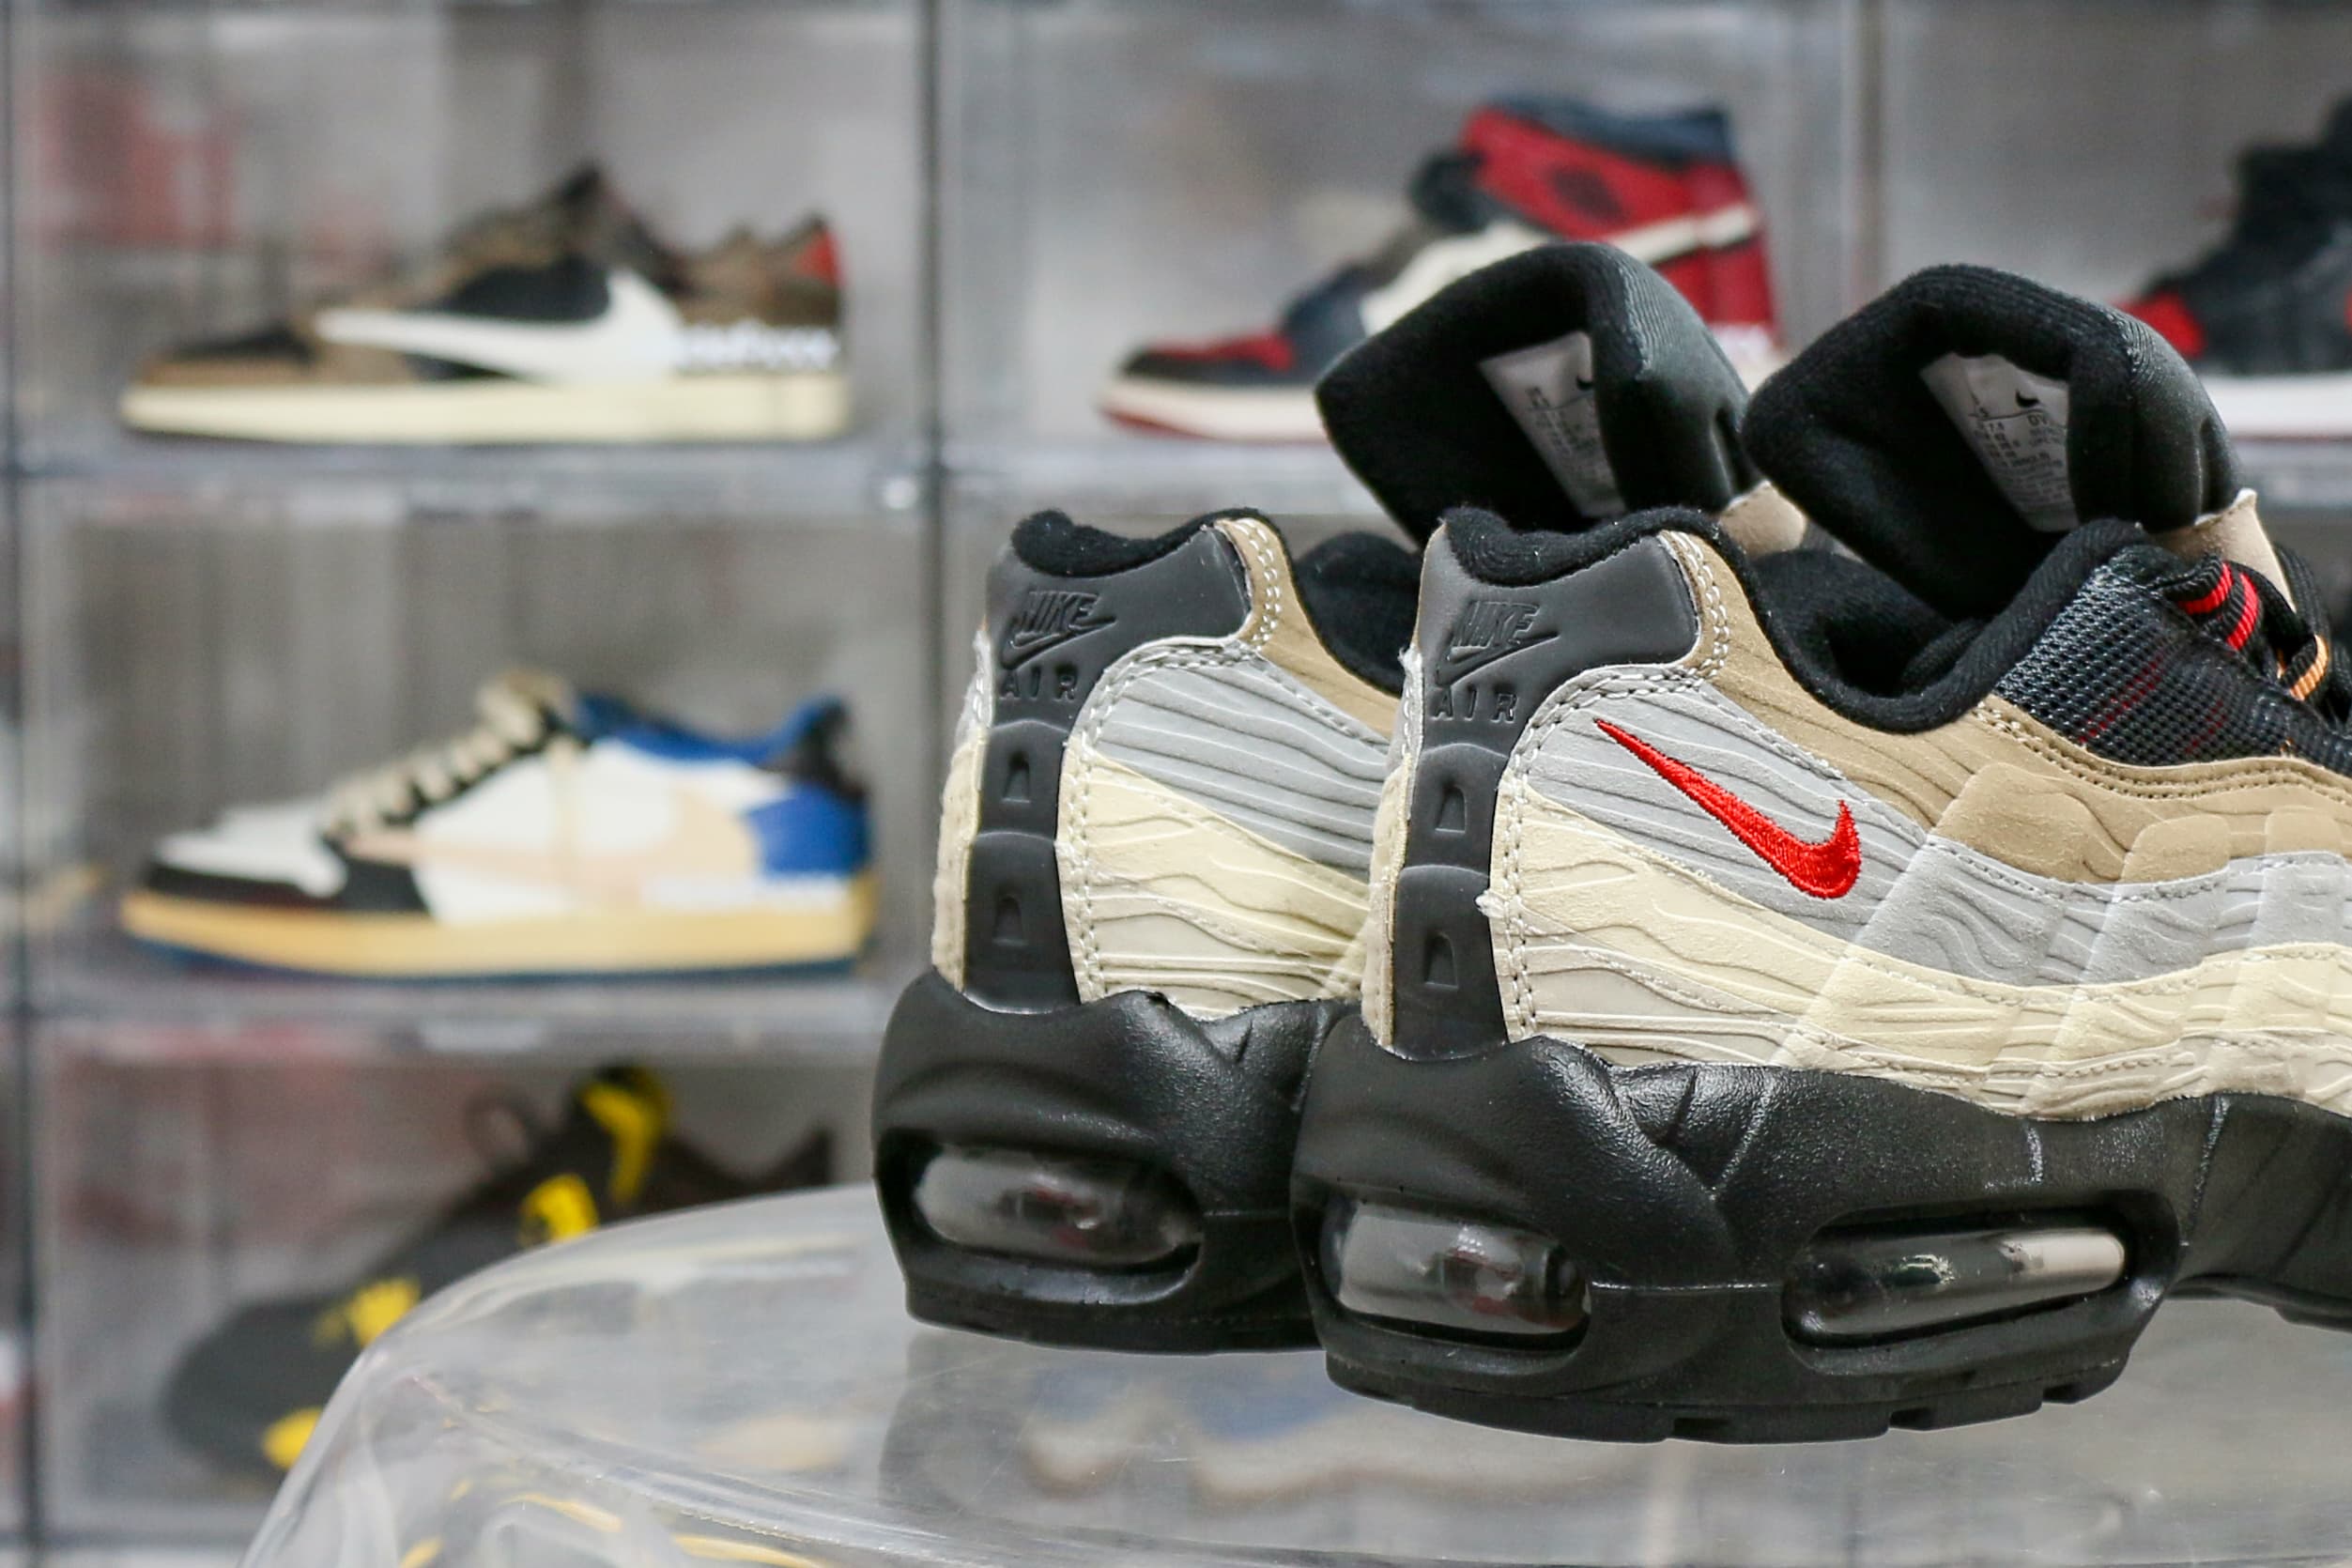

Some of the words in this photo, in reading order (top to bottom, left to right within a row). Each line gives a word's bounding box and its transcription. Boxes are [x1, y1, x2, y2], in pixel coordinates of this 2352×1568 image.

[1010, 590, 1100, 635] NIKE
[1452, 600, 1541, 646] NIKE
[998, 666, 1079, 700] AIR
[1429, 685, 1518, 723] AIR
